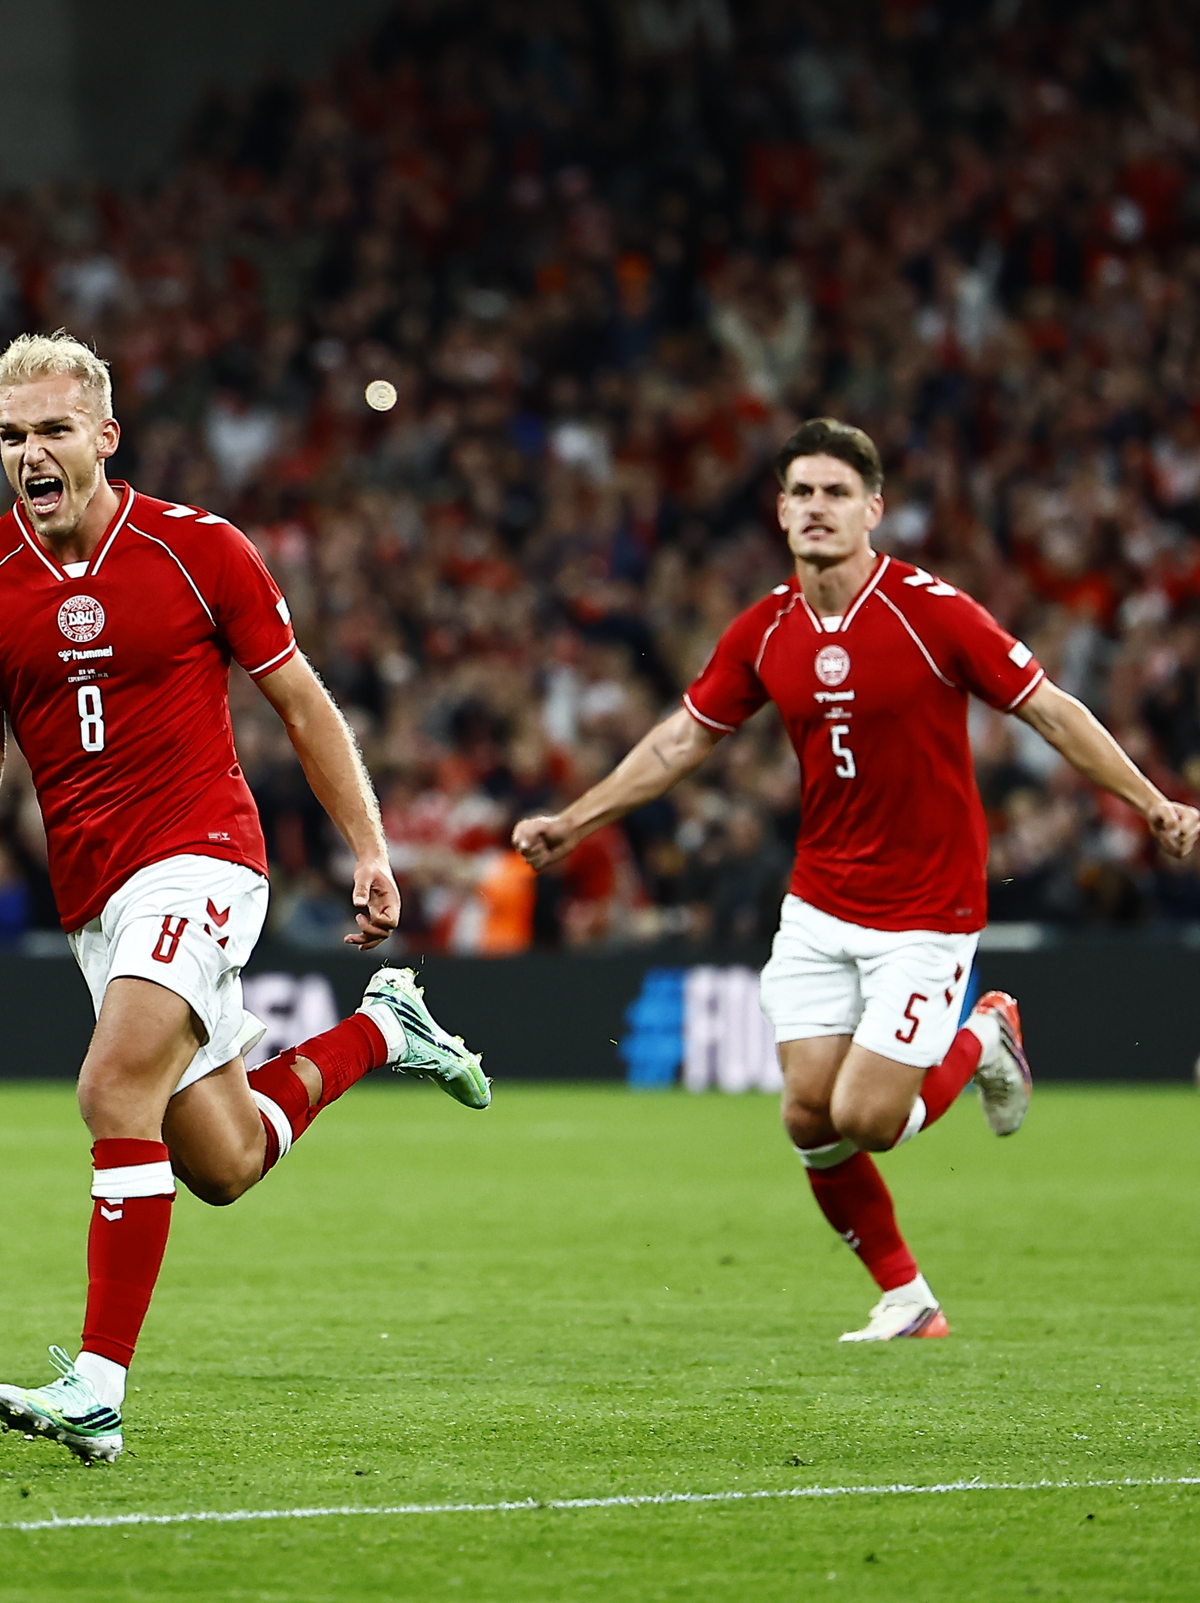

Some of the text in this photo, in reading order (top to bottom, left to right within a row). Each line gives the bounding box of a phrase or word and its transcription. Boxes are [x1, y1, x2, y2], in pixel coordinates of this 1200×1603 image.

[67, 610, 96, 627] DBU
[72, 645, 114, 661] hummel
[77, 685, 105, 752] 8
[830, 724, 856, 779] 5
[151, 914, 189, 964] 8
[895, 992, 928, 1044] 5
